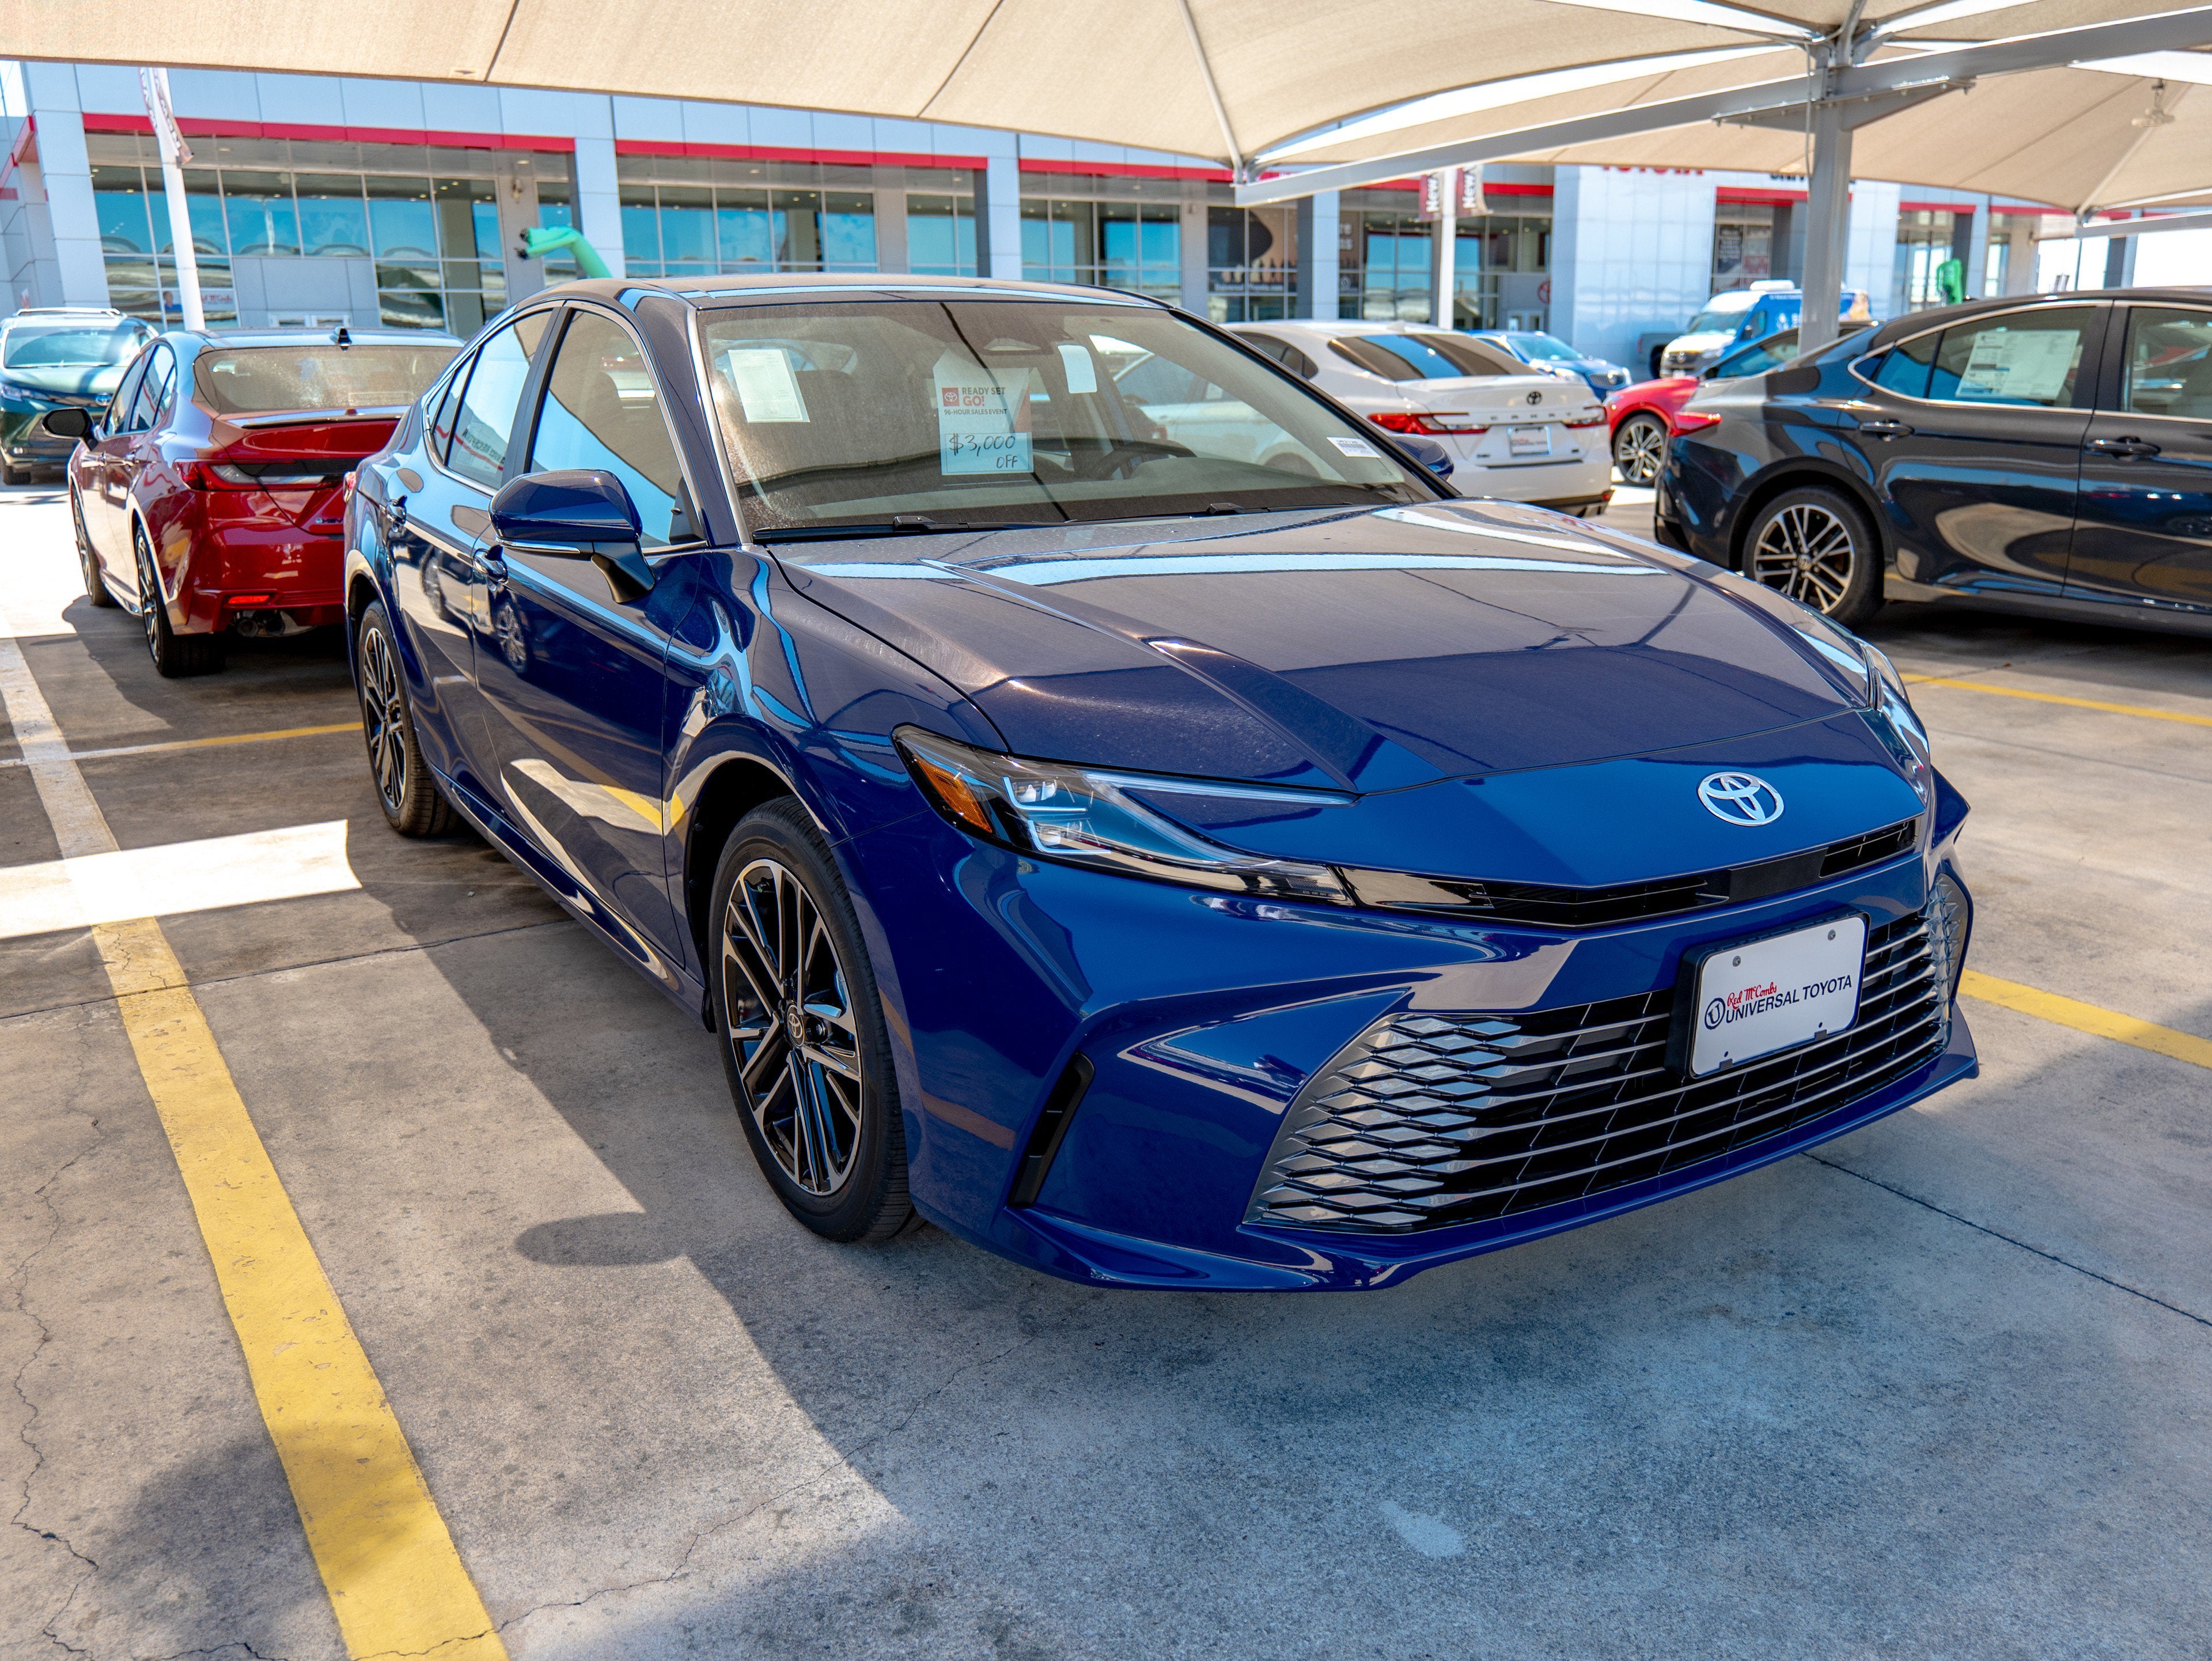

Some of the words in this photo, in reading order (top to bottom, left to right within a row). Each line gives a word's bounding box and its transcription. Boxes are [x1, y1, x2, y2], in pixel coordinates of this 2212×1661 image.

[1426, 178, 1439, 213] New
[1462, 173, 1476, 209] New
[961, 387, 989, 395] READY
[991, 387, 1006, 395] SET
[963, 395, 985, 407] GO!
[949, 433, 1016, 457] $3,000
[996, 454, 1018, 468] OFF
[1725, 989, 1800, 1024] UNIVERSAL
[1802, 975, 1852, 1000] TOYOTA
[1727, 990, 1743, 1010] Red
[1744, 981, 1777, 1002] McCombs
